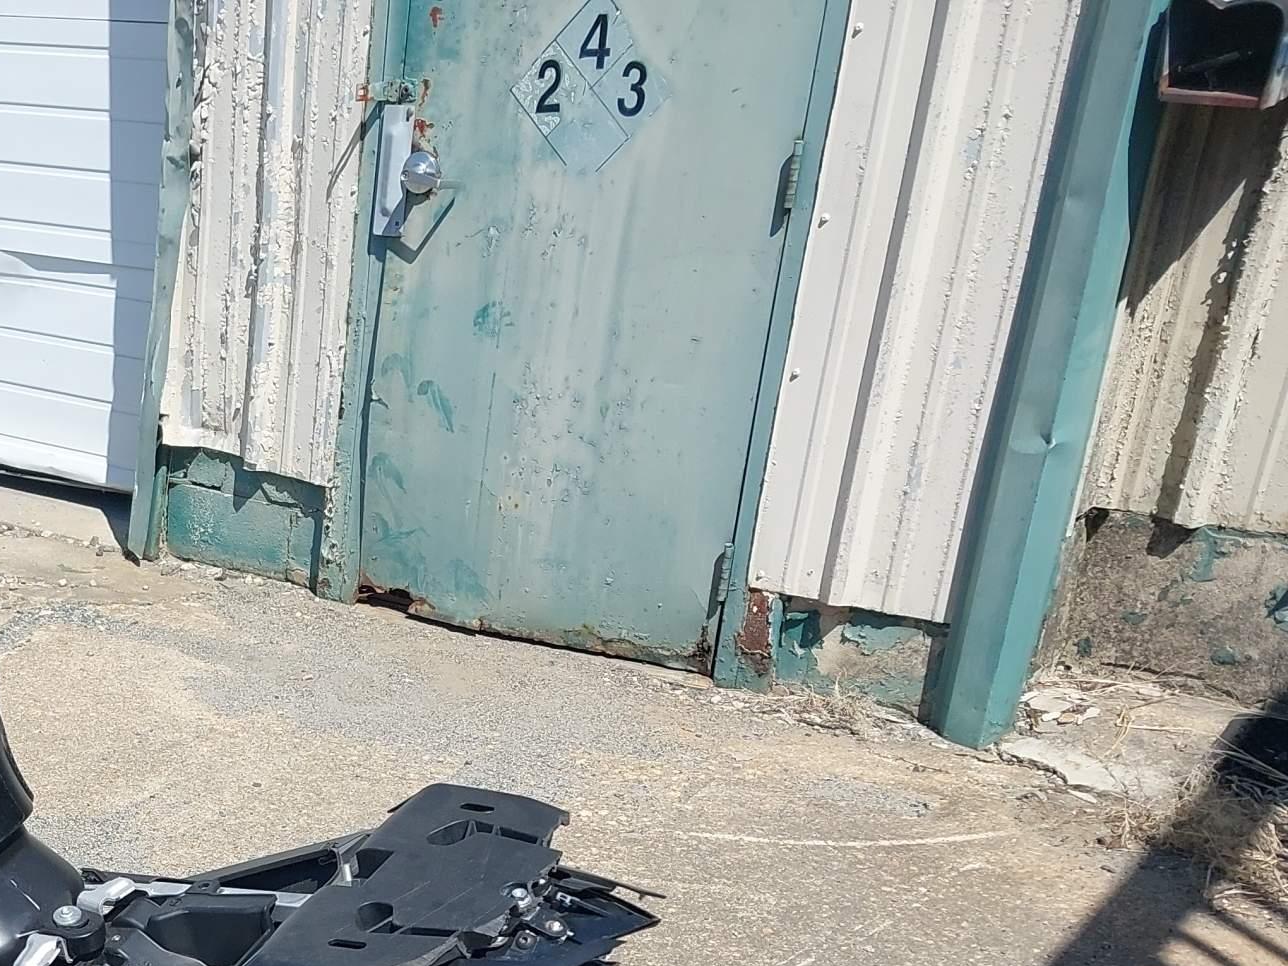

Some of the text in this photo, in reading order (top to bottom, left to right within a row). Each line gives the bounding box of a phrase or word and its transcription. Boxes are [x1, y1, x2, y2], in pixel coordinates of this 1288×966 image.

[579, 13, 611, 70] 4
[535, 59, 562, 114] 2
[617, 60, 648, 118] 3
